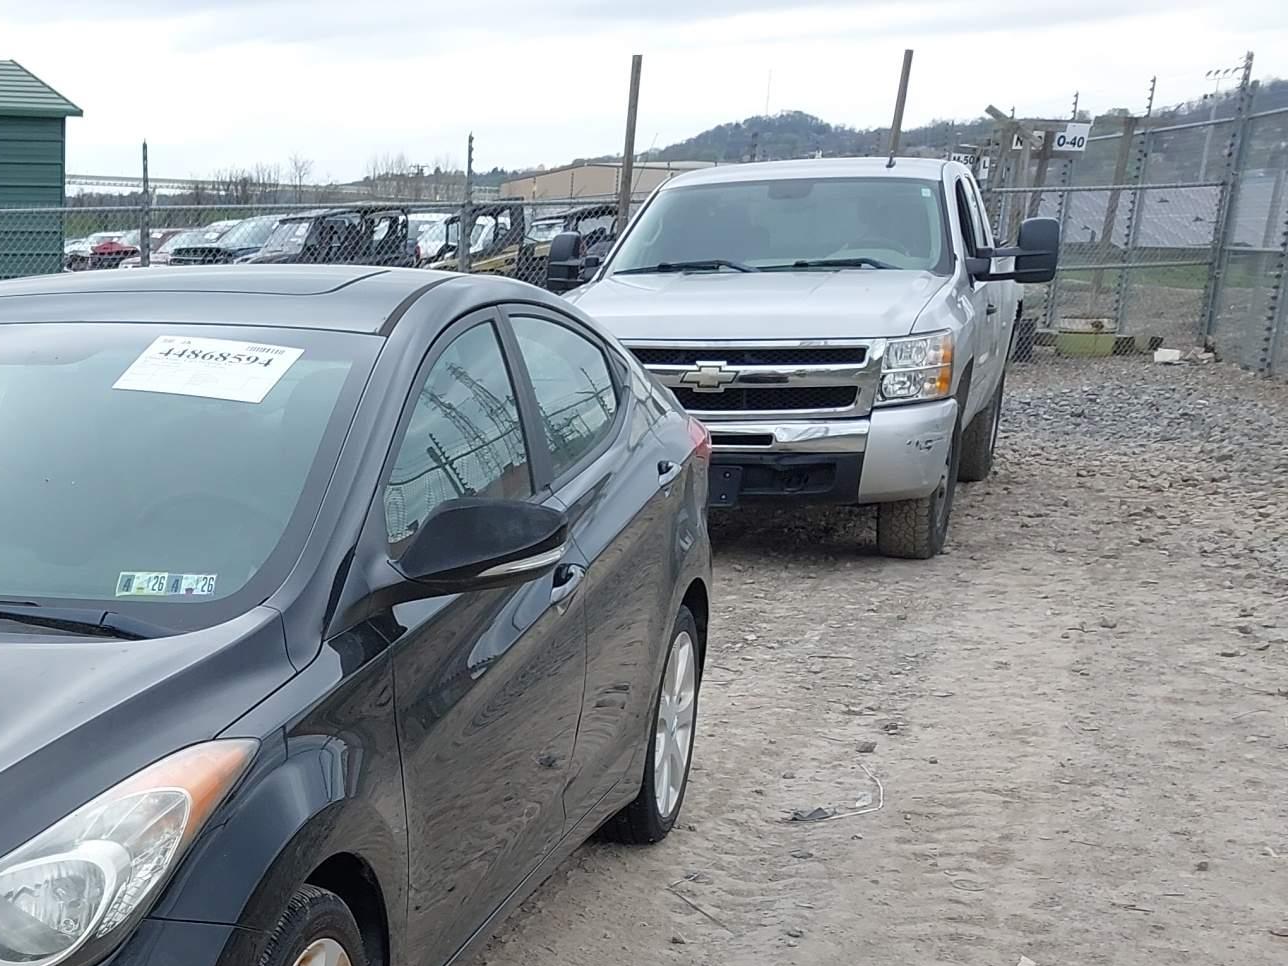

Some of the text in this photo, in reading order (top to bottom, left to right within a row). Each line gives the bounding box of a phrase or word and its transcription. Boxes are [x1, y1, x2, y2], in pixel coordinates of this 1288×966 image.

[159, 347, 274, 367] 44868594
[151, 575, 166, 591] 26
[200, 576, 215, 593] 26
